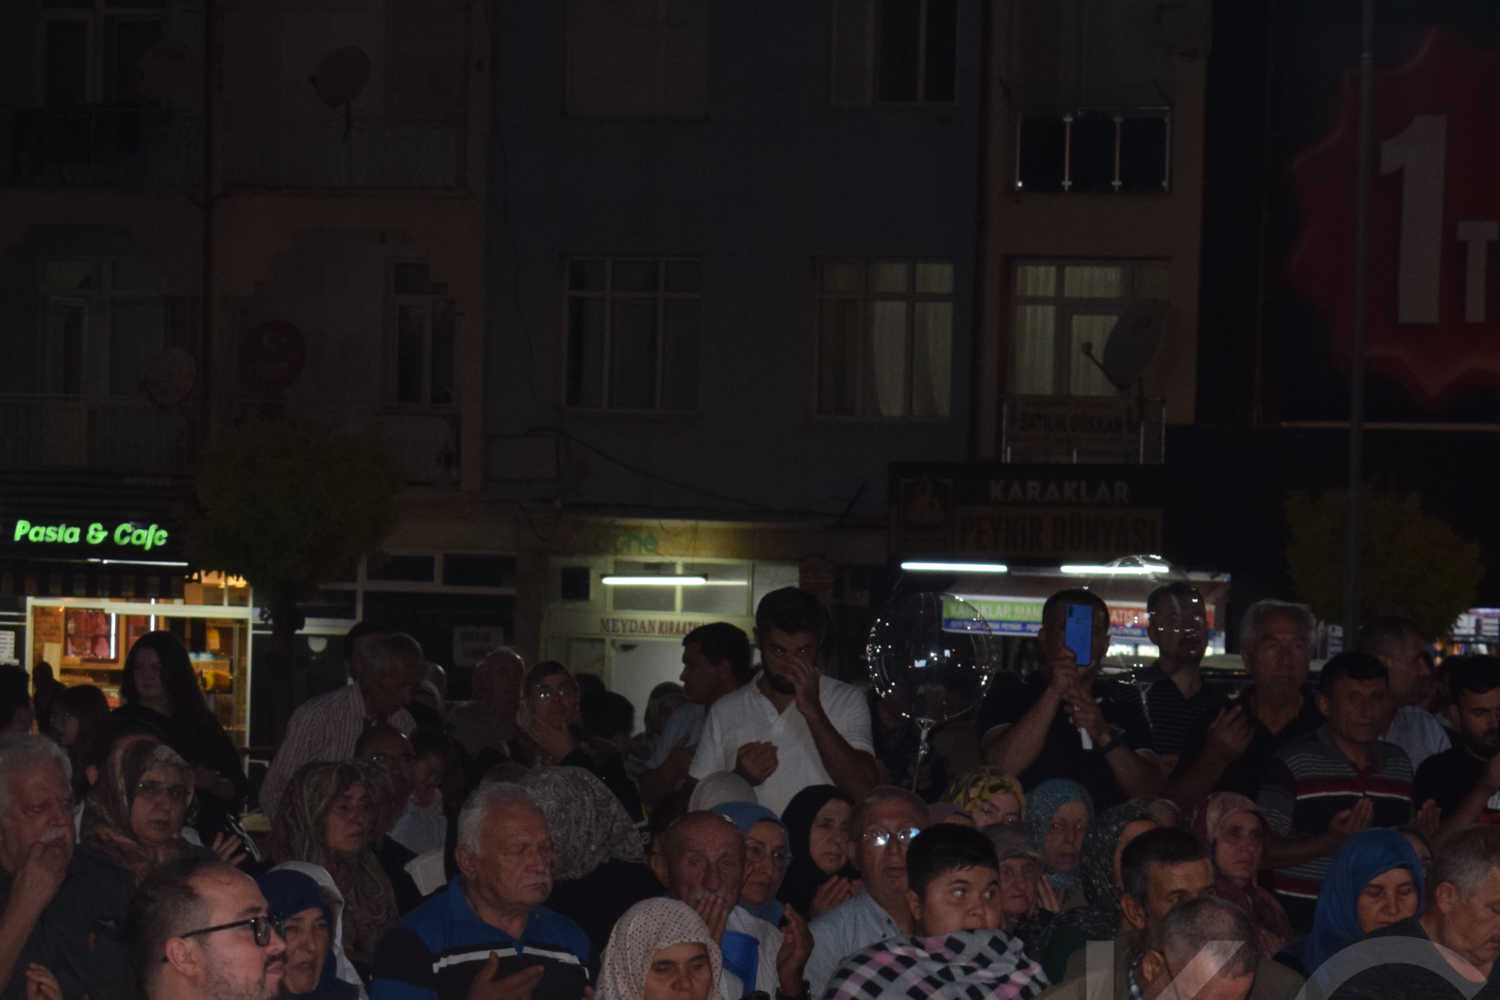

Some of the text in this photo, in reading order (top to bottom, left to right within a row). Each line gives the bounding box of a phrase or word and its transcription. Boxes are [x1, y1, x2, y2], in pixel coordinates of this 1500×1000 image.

[1378, 113, 1449, 324] 1
[991, 479, 1130, 504] KARAKLAR
[85, 521, 109, 545] &
[600, 617, 658, 635] MEYDAN
